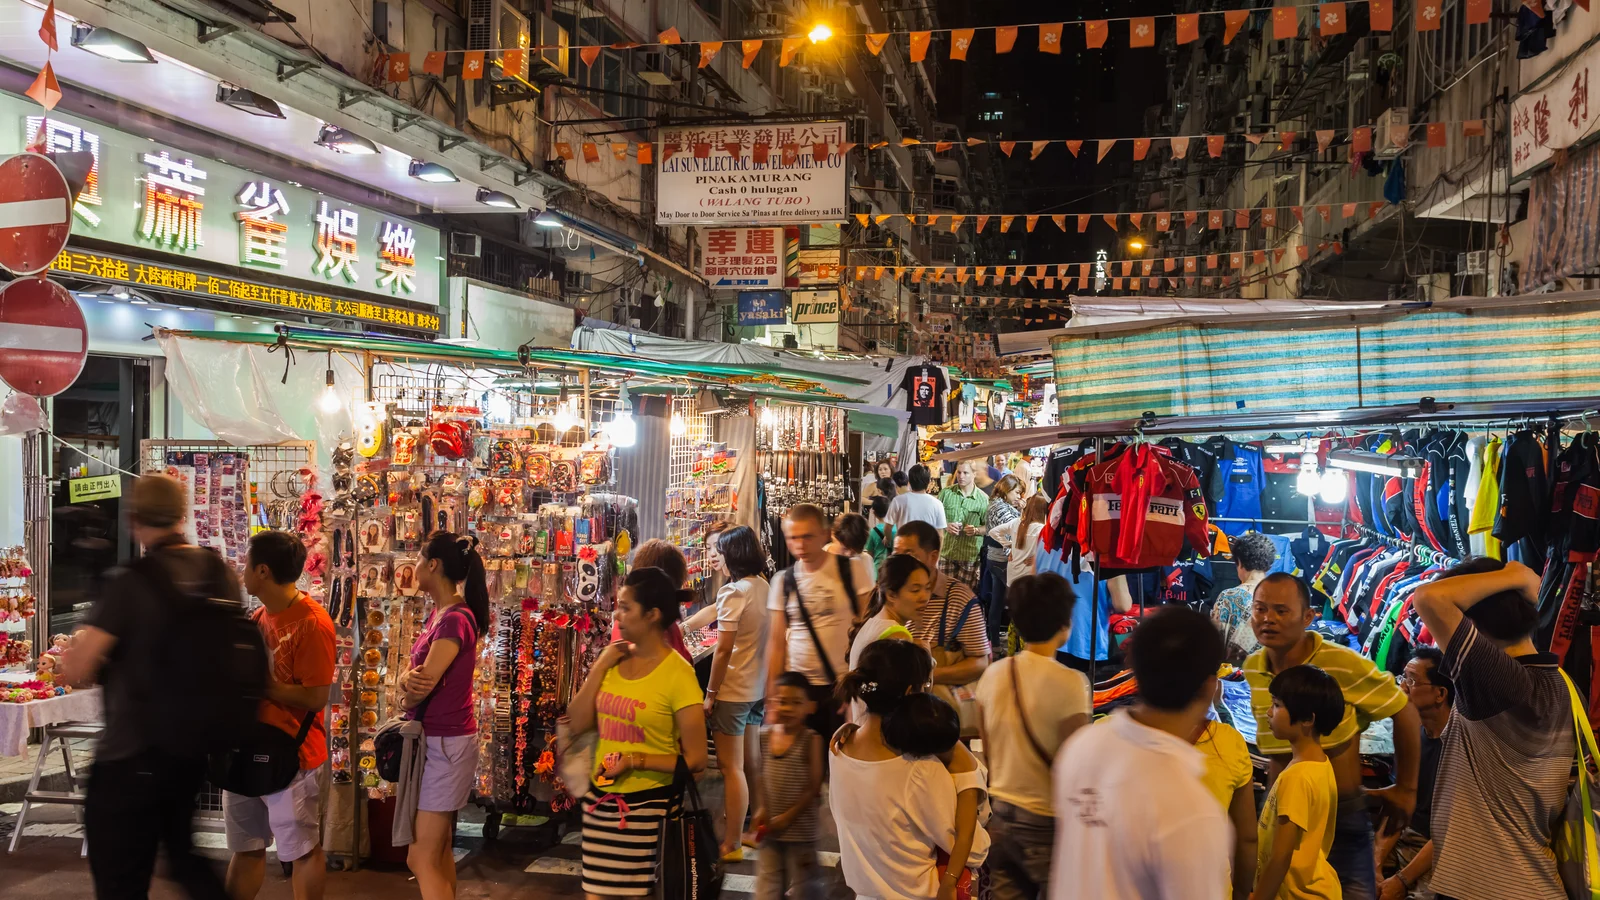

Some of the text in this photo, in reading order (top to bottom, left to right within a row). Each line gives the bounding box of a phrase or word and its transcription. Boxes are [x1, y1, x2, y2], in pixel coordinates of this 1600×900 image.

[662, 152, 842, 173] LAI SUN ELECTRIC VELMEN CO
[695, 173, 812, 184] PINAKAMURANG
[751, 186, 798, 194] hulugan
[660, 211, 673, 219] May
[700, 210, 715, 218] Door
[780, 208, 793, 216] free
[795, 208, 821, 217] delivery
[708, 230, 774, 254] 幸運
[50, 251, 129, 281] 由三六拾起
[794, 300, 837, 321] prince
[75, 480, 116, 492] 請由正門出入
[1108, 499, 1179, 517] Ferari
